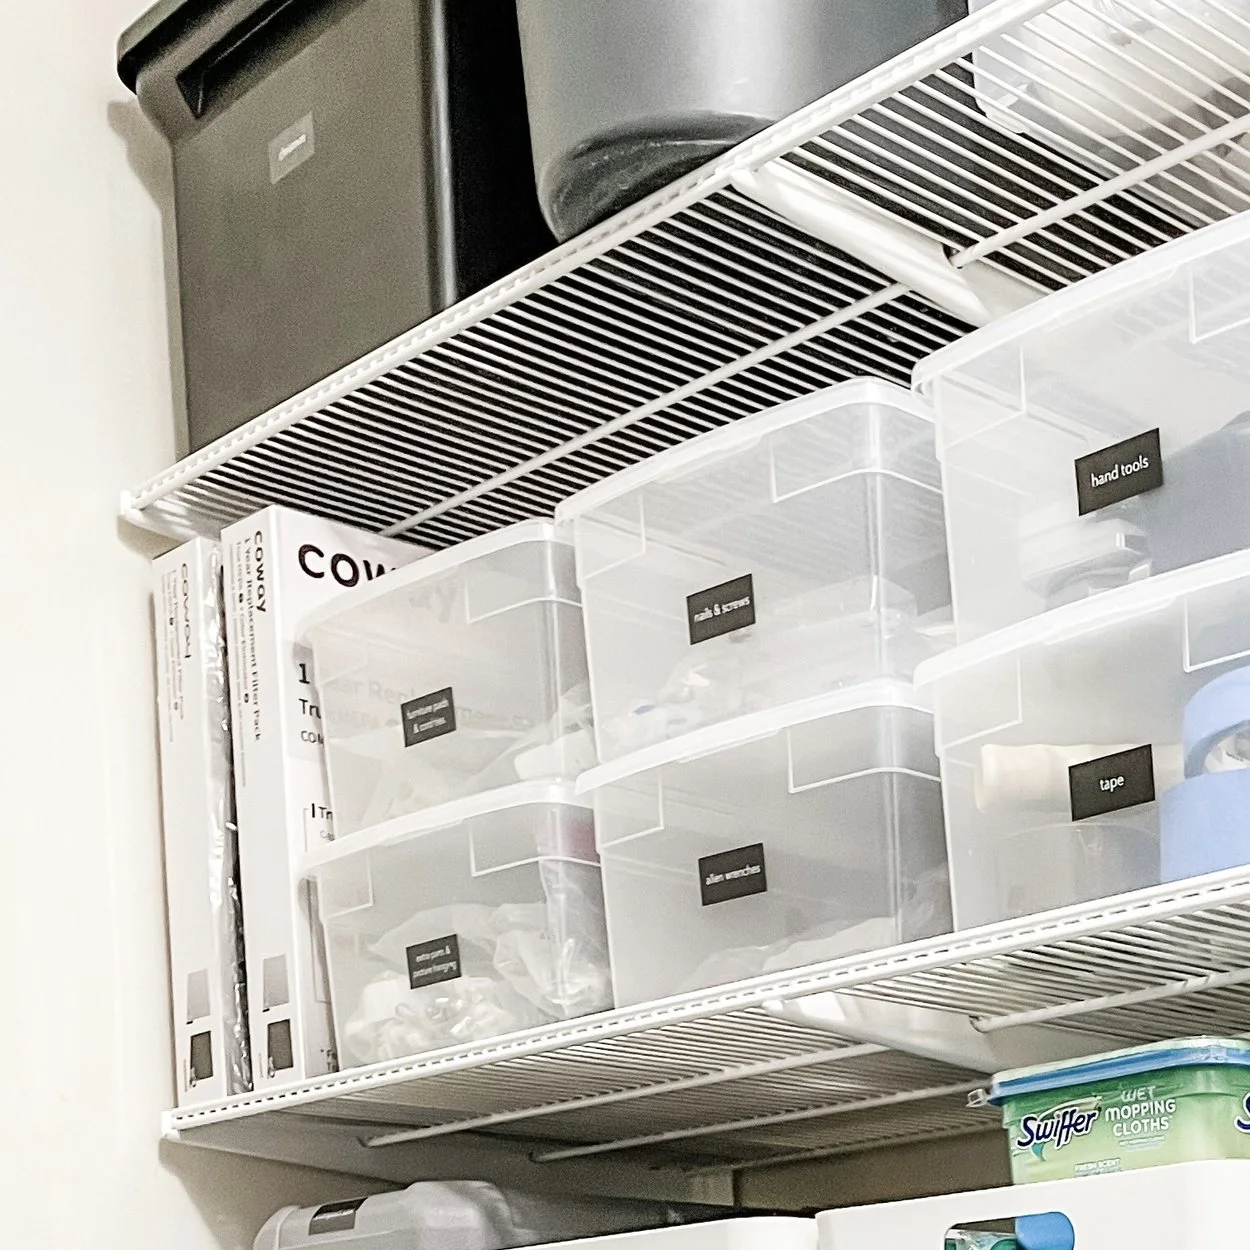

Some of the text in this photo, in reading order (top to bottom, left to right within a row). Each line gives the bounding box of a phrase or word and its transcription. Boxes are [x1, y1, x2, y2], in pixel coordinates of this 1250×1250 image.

[1091, 455, 1149, 487] hand tools
[713, 603, 721, 616] &
[722, 596, 751, 614] screws
[1099, 776, 1124, 792] tape
[705, 864, 761, 886] allen wrenches
[1121, 1085, 1157, 1102] WET
[1105, 1098, 1176, 1122] MOPPING
[1017, 1107, 1099, 1149] Swiffer
[1113, 1116, 1171, 1137] CLOTHS
